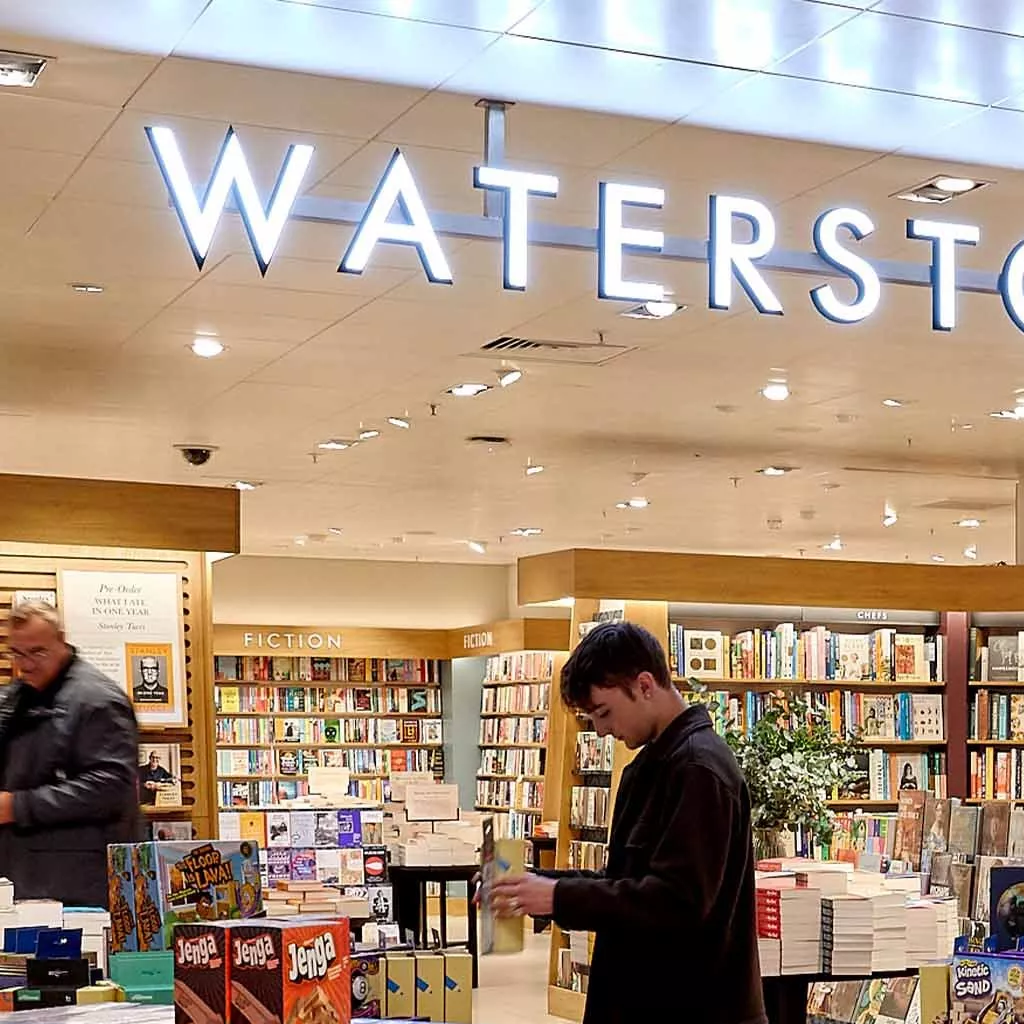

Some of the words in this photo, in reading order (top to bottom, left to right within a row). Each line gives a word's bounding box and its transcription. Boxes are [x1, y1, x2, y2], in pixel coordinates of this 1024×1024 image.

[92, 607, 102, 616] IN
[126, 607, 150, 617] YEAR
[856, 610, 888, 621] CHEFS
[243, 632, 342, 649] FICTION
[463, 631, 493, 649] FICTION
[191, 851, 221, 869] FLOOR
[194, 861, 233, 889] LAVA!
[177, 935, 217, 965] Jenga
[234, 935, 275, 966] Jenga
[287, 931, 336, 981] Jenga
[956, 963, 990, 979] Kinetic
[955, 980, 991, 997] SAND
